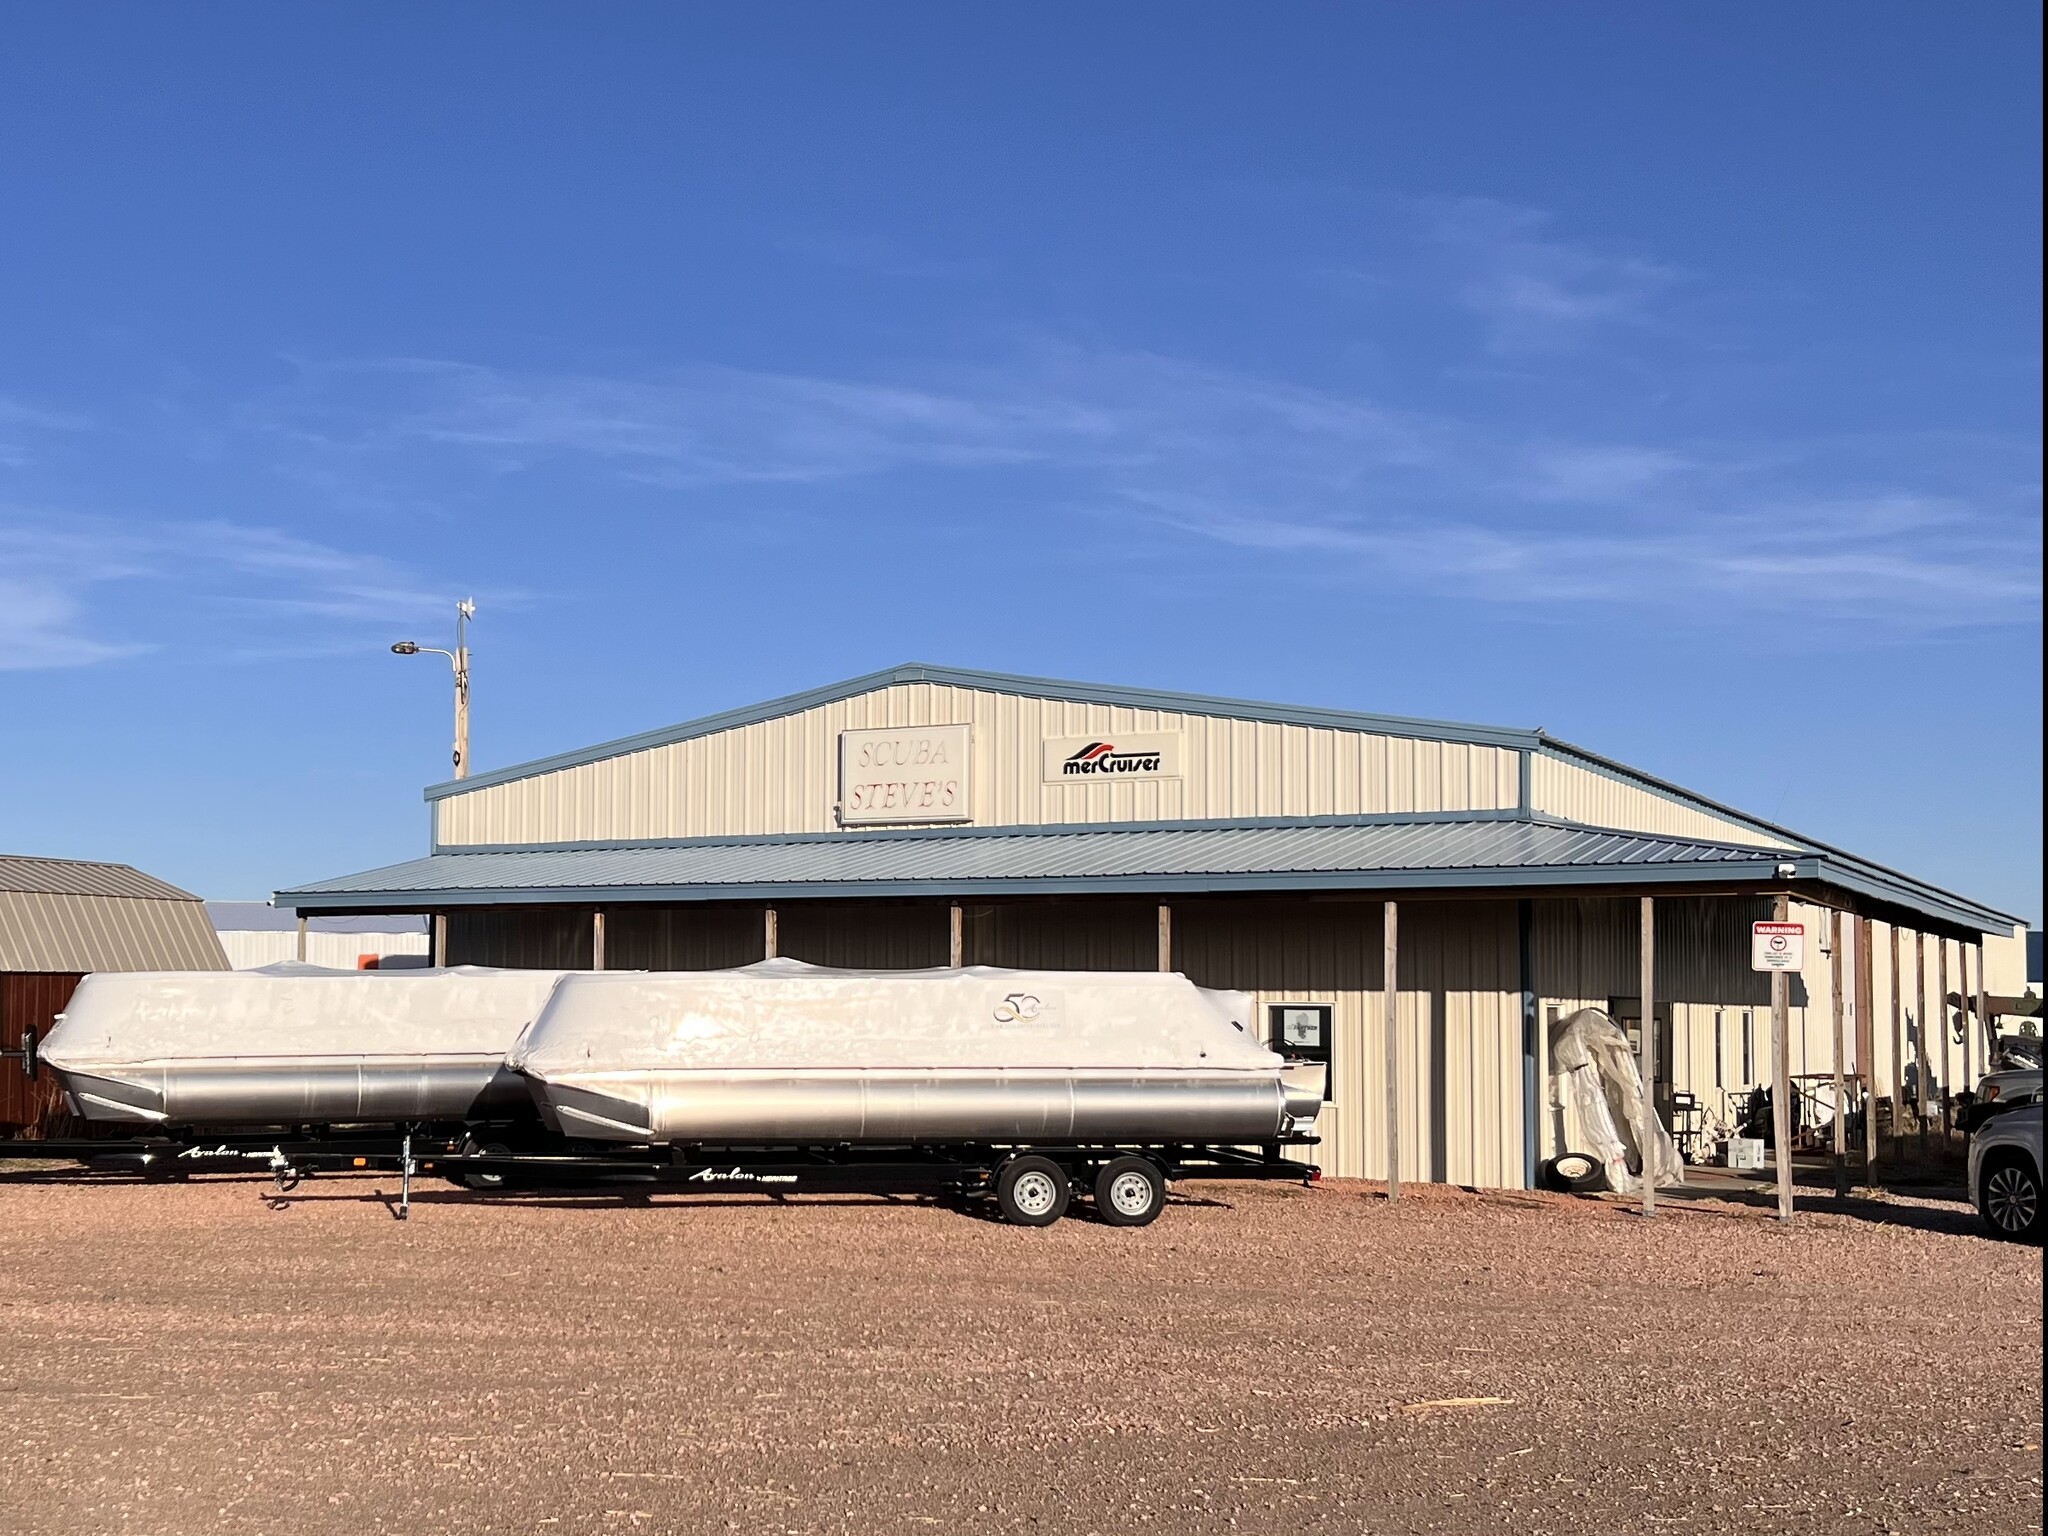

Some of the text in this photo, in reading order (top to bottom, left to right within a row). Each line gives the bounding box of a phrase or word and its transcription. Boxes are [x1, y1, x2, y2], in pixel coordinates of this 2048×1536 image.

[859, 740, 949, 768] SCUBA
[1063, 752, 1160, 775] merCruiser
[850, 780, 957, 810] STEVE'S
[1756, 926, 1802, 934] WARNING
[177, 1144, 239, 1158] Avalon
[688, 1166, 755, 1182] Avalon
